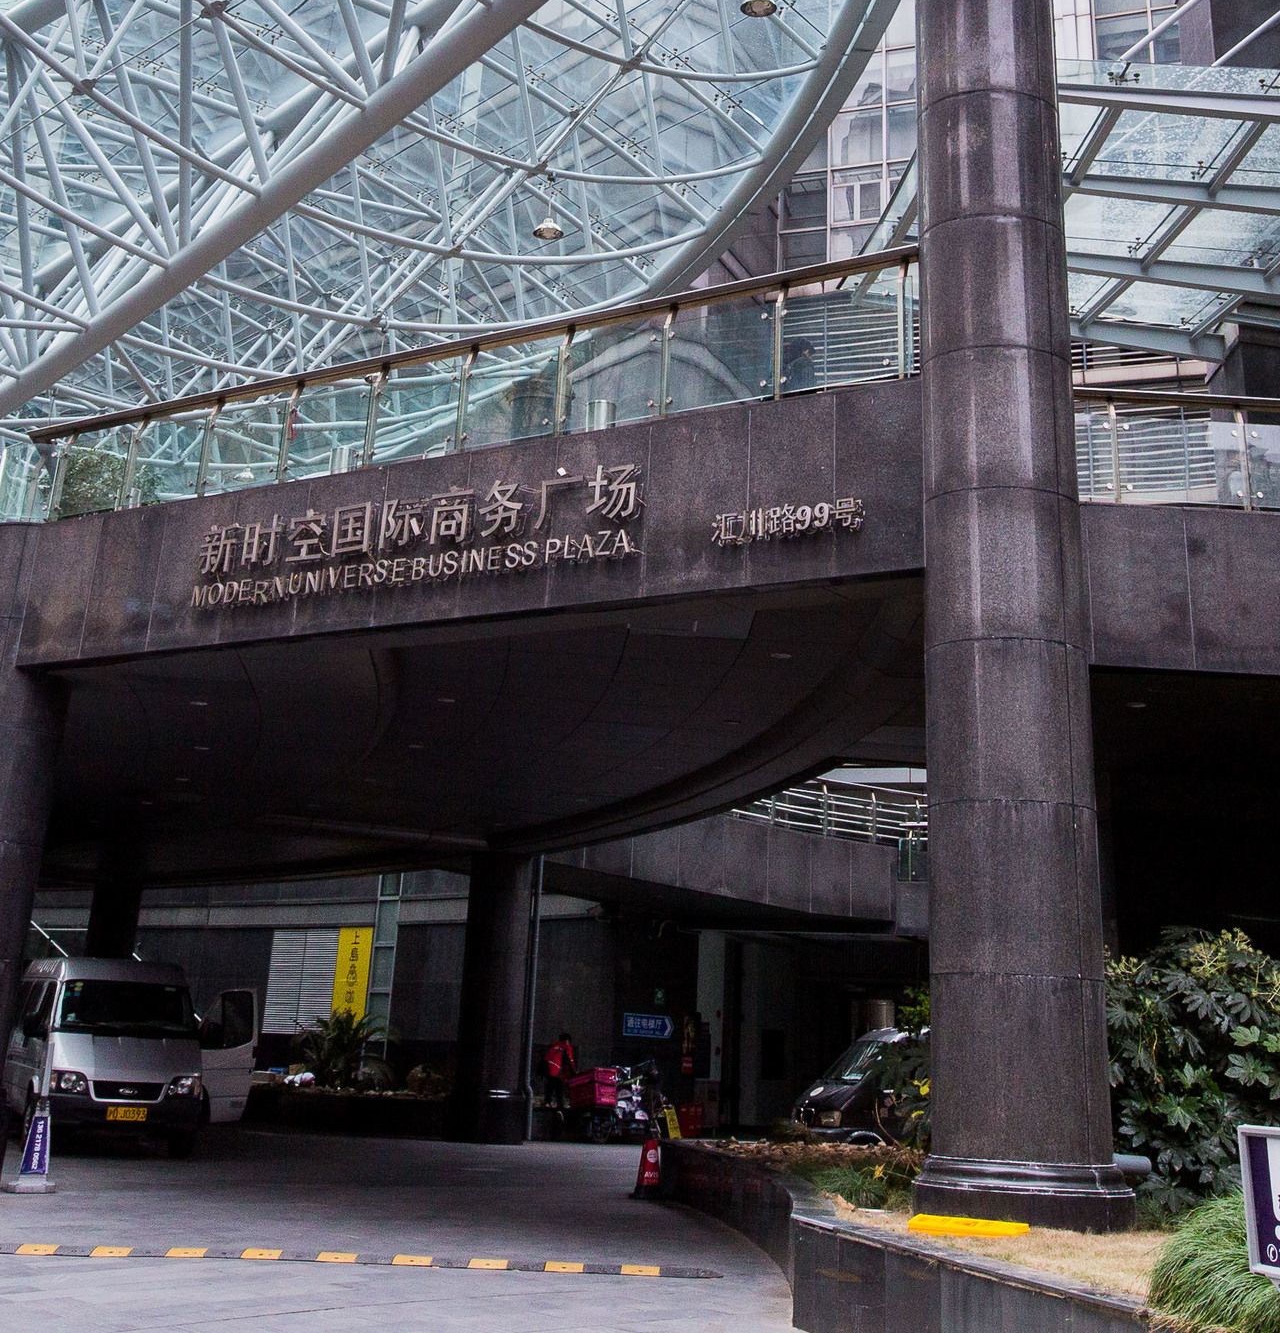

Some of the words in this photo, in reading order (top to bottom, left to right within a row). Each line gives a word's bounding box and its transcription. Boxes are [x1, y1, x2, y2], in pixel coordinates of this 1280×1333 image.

[199, 463, 638, 575] 新时空国际商务广场
[710, 496, 860, 543] 汇川路99号
[190, 577, 285, 608] MODERN
[288, 557, 408, 596] UNIVERSE
[411, 540, 539, 581] BUSINESS
[544, 528, 632, 564] PLAZA
